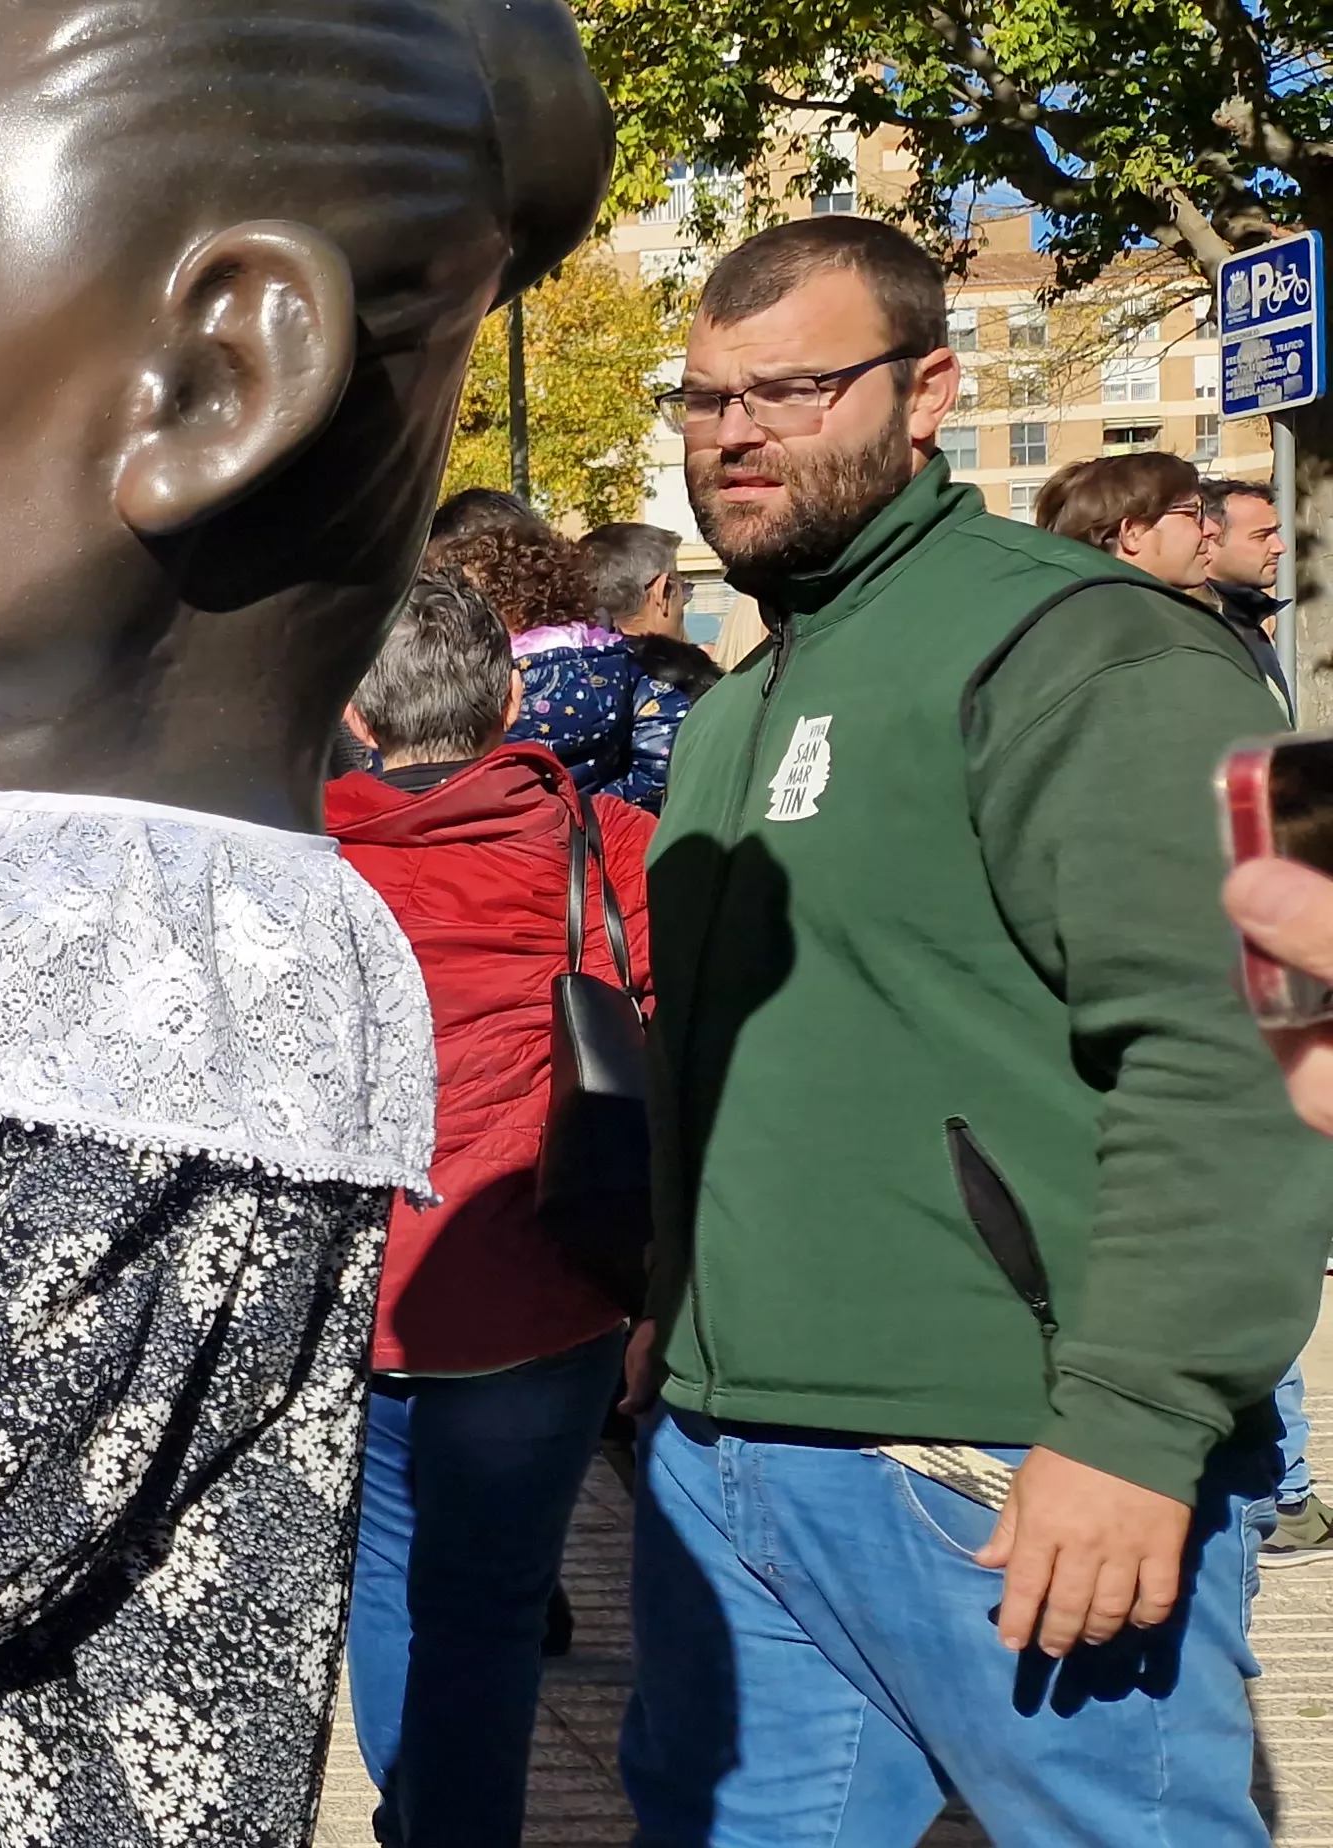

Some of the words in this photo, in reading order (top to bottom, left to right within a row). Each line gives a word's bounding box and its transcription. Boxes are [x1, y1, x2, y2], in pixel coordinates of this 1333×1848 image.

[809, 724, 827, 738] VIVA
[793, 740, 821, 764] SAN
[786, 765, 812, 785] MAR
[779, 787, 807, 815] TIN
